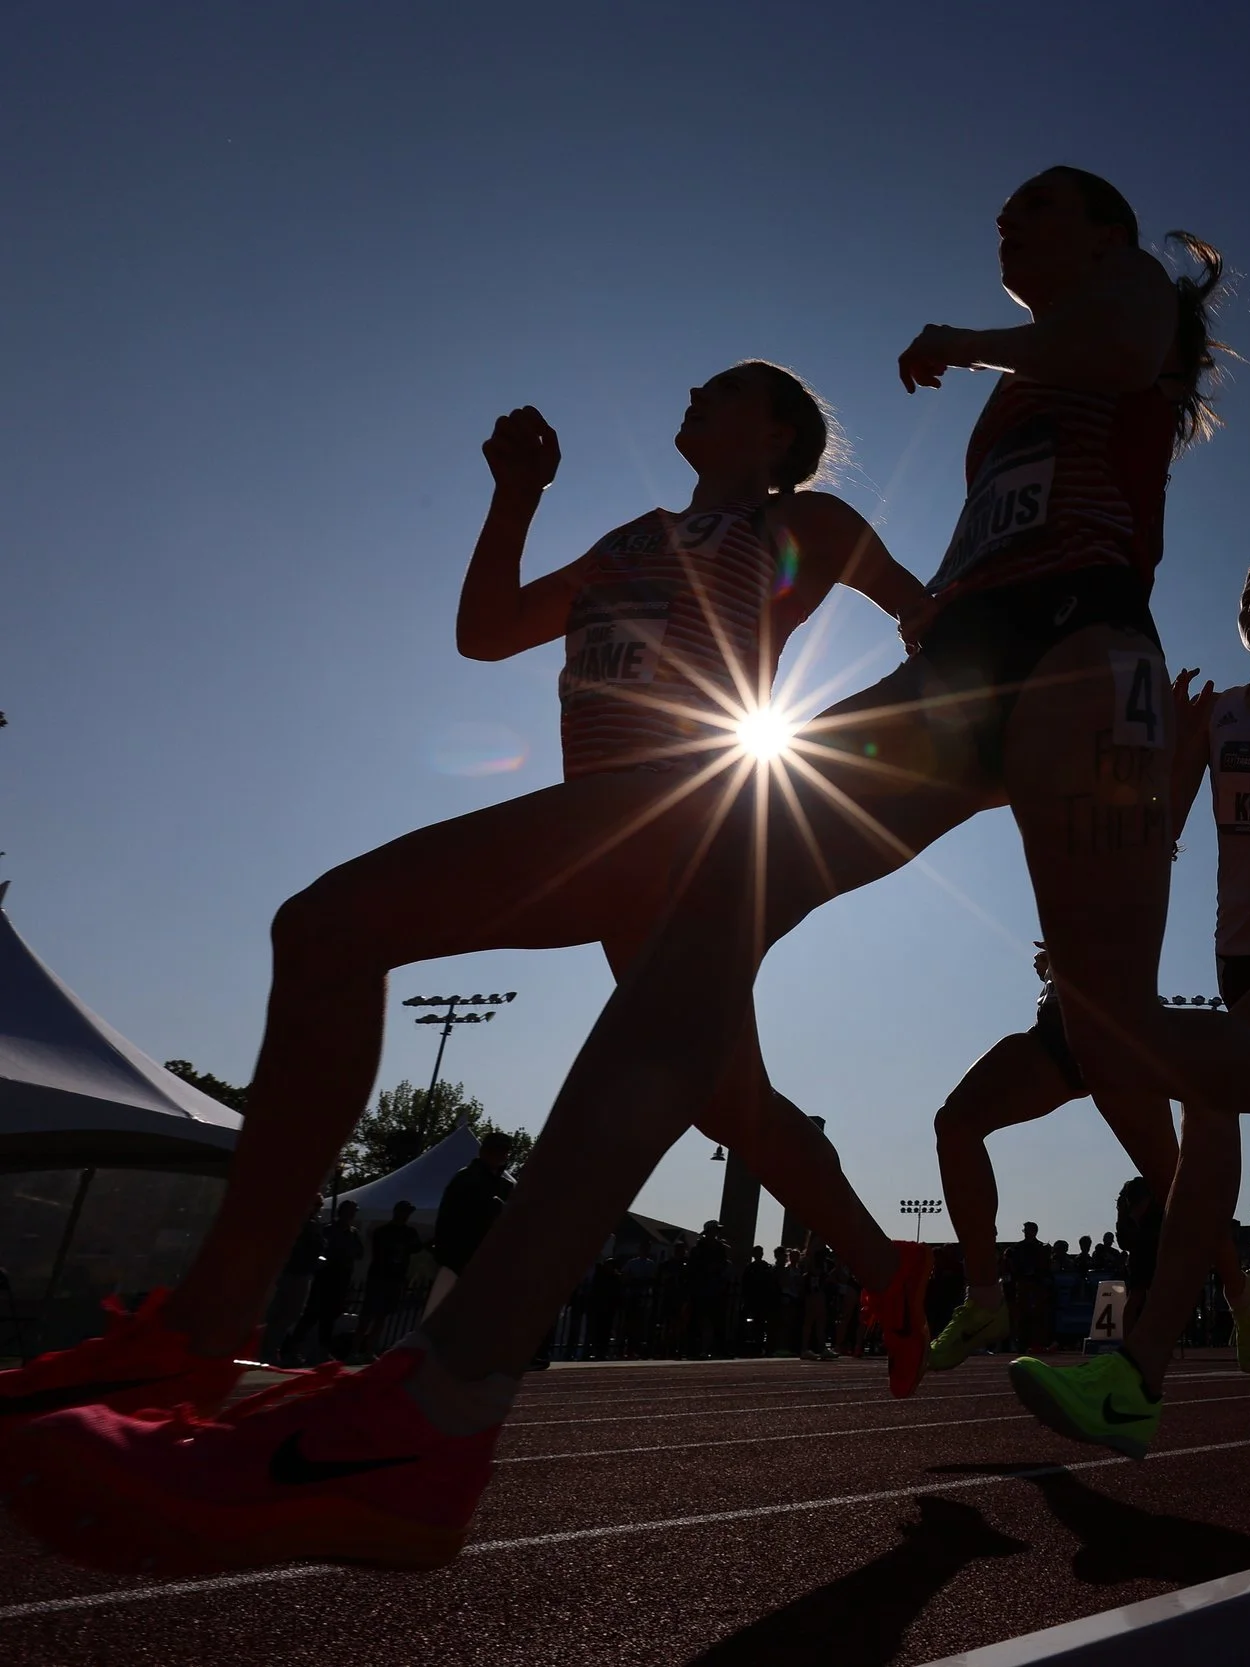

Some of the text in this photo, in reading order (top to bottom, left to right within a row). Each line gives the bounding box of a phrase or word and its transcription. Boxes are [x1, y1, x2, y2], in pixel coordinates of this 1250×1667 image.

[679, 514, 722, 549] 9
[1127, 658, 1157, 742] 4
[1095, 1303, 1116, 1338] 4
